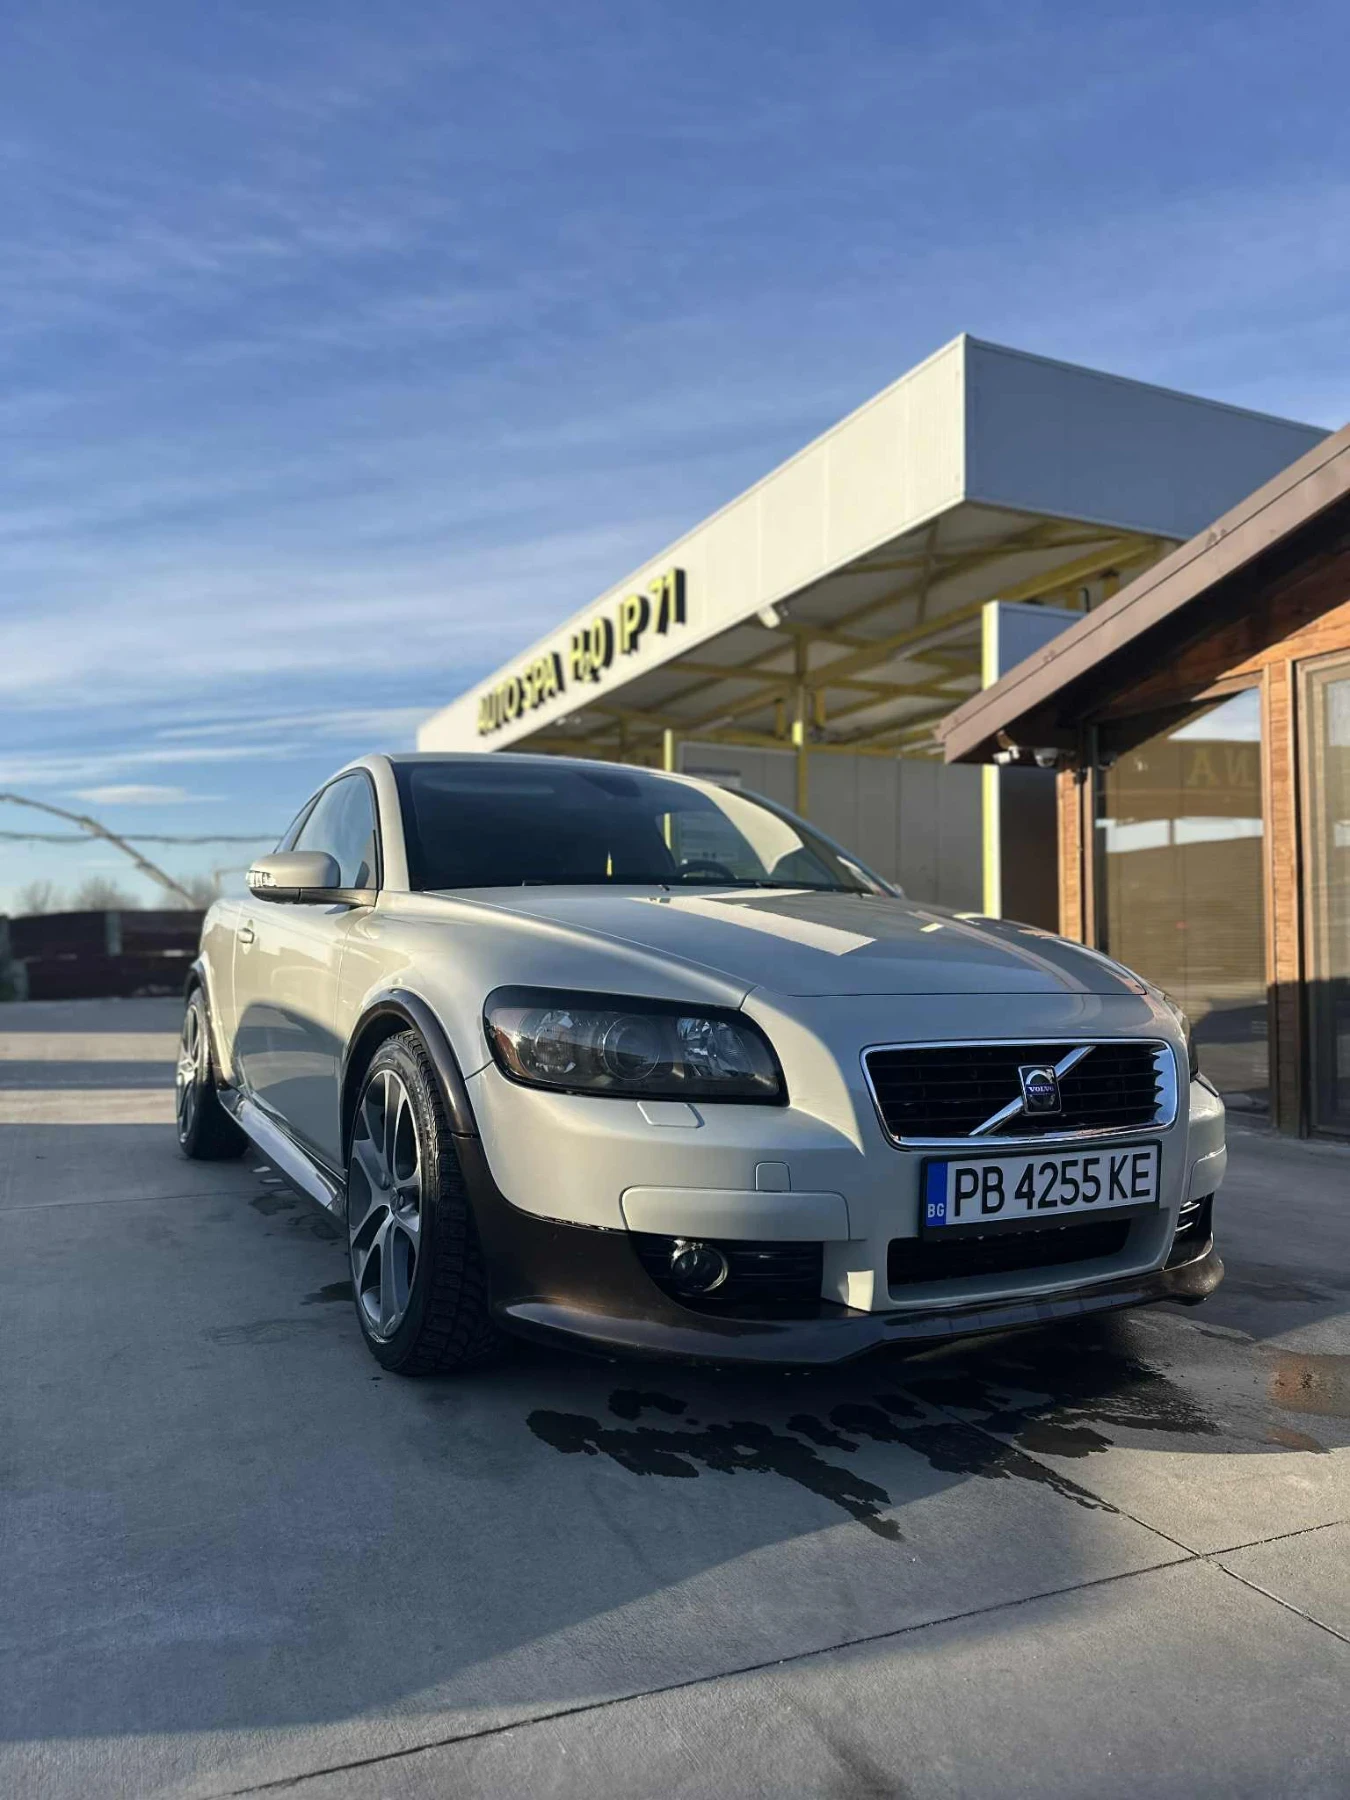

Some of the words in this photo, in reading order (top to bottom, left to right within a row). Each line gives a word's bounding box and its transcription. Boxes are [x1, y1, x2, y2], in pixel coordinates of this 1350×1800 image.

[954, 1165, 1004, 1217] PB
[1014, 1158, 1101, 1210] 4255
[1109, 1153, 1151, 1201] KE
[927, 1203, 944, 1218] BG
